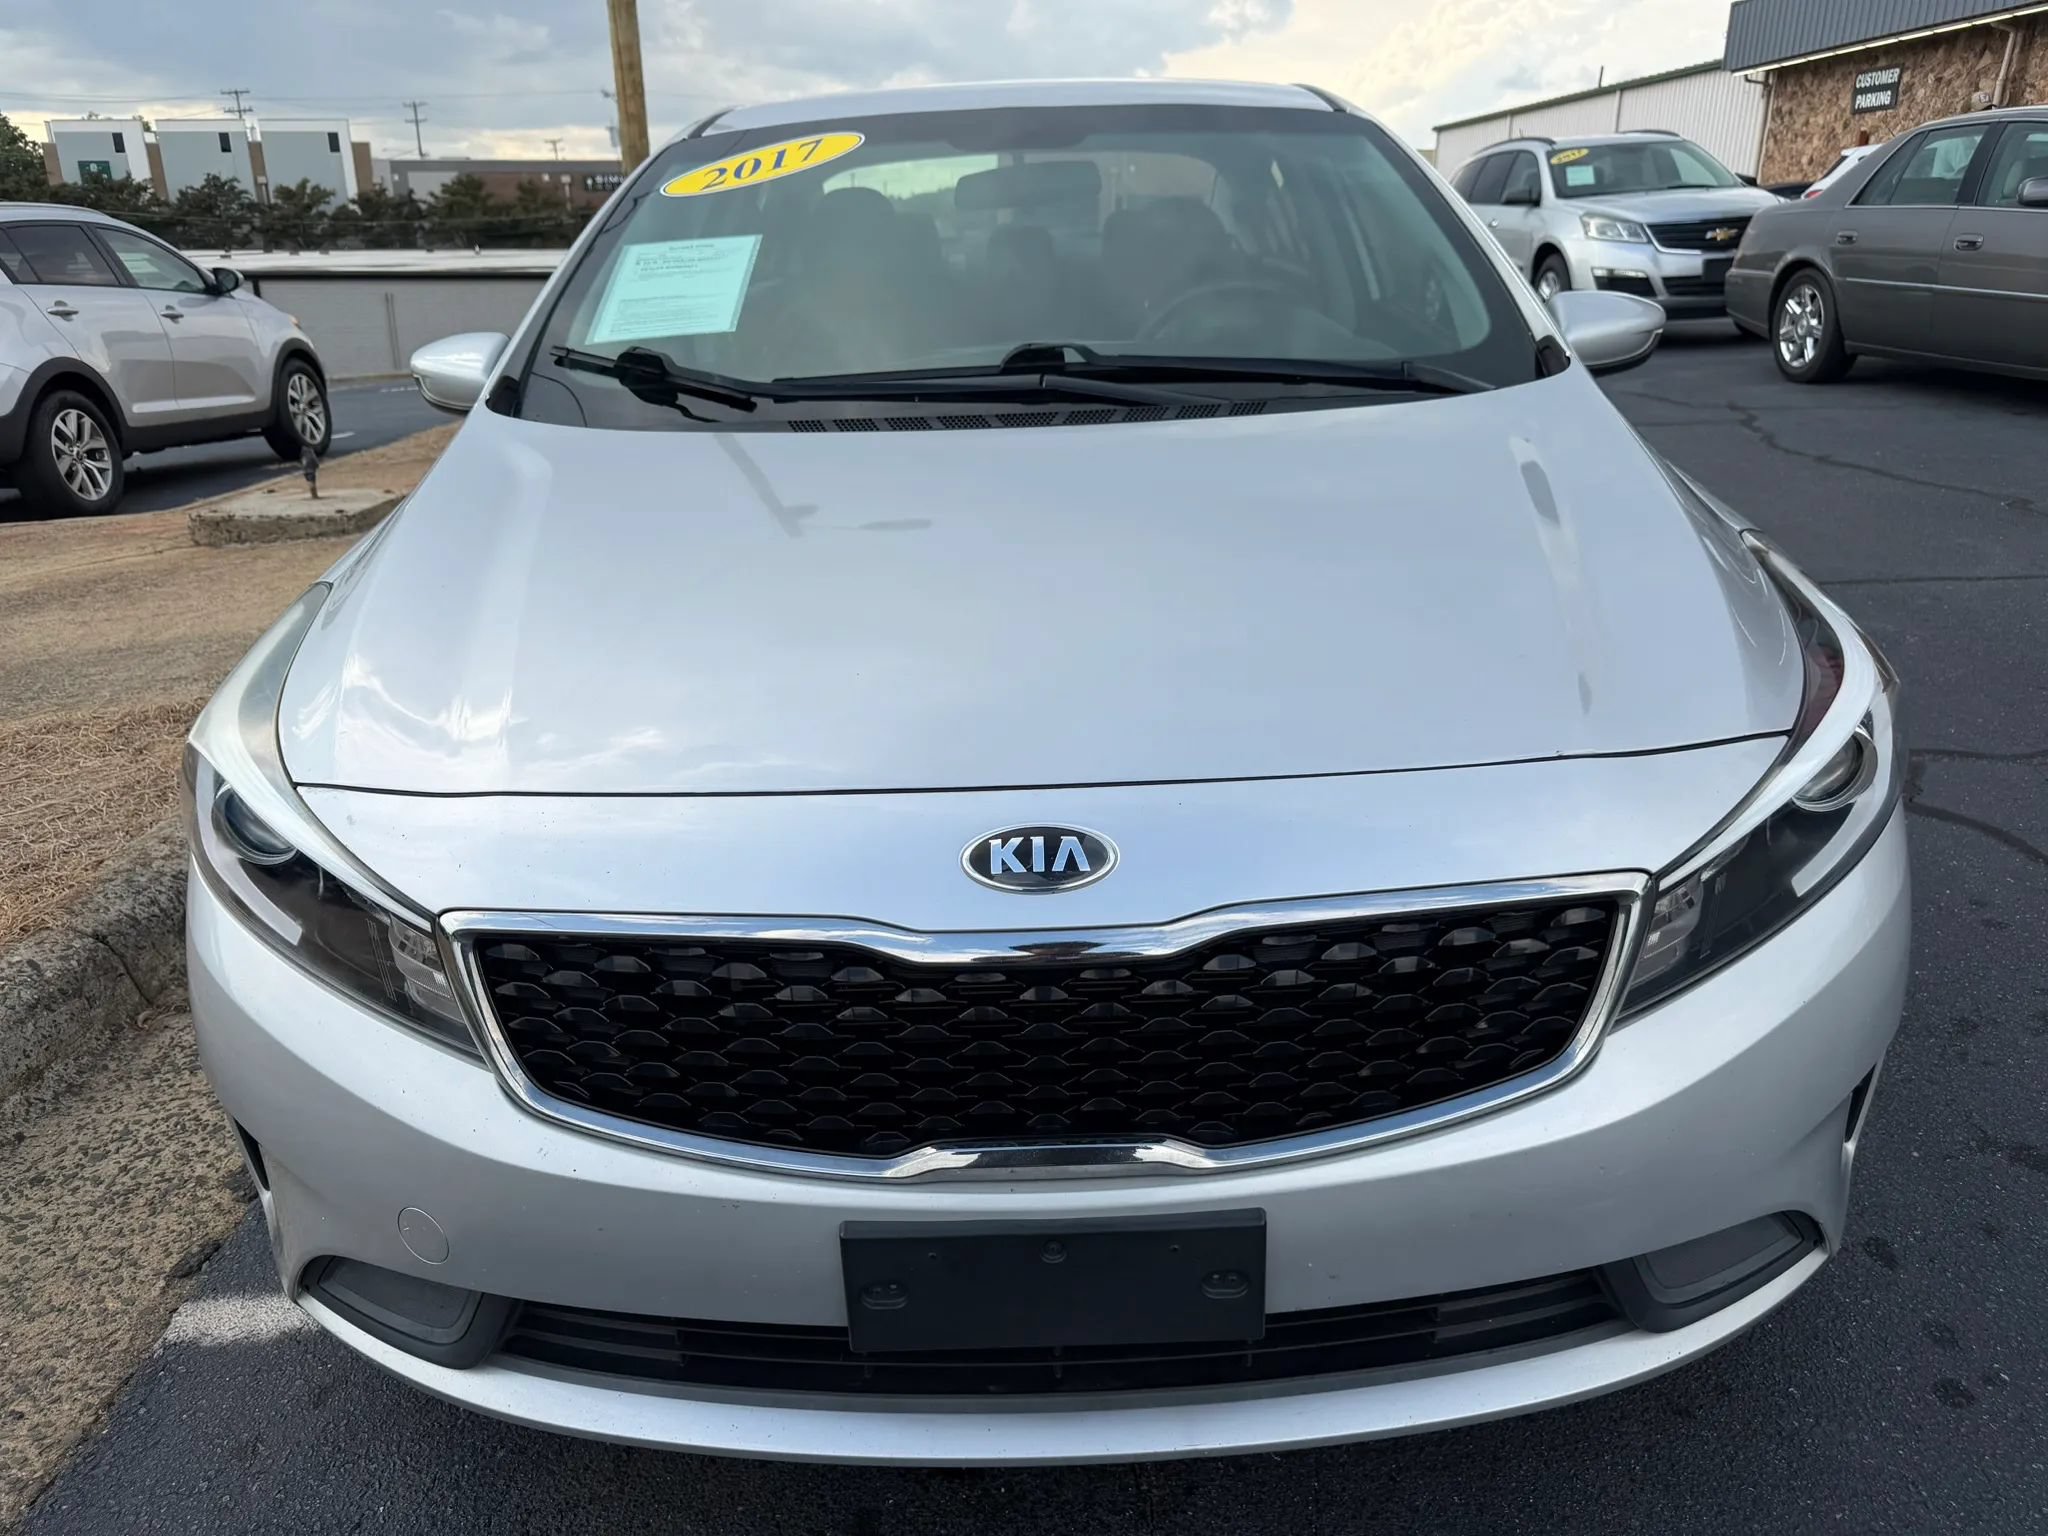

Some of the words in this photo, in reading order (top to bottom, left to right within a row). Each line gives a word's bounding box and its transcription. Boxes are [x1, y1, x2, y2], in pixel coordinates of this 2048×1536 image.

[1856, 68, 1900, 89] CUSTOMER
[1855, 90, 1891, 110] PARKING
[700, 138, 824, 191] 2017
[988, 836, 1091, 875] KIA
